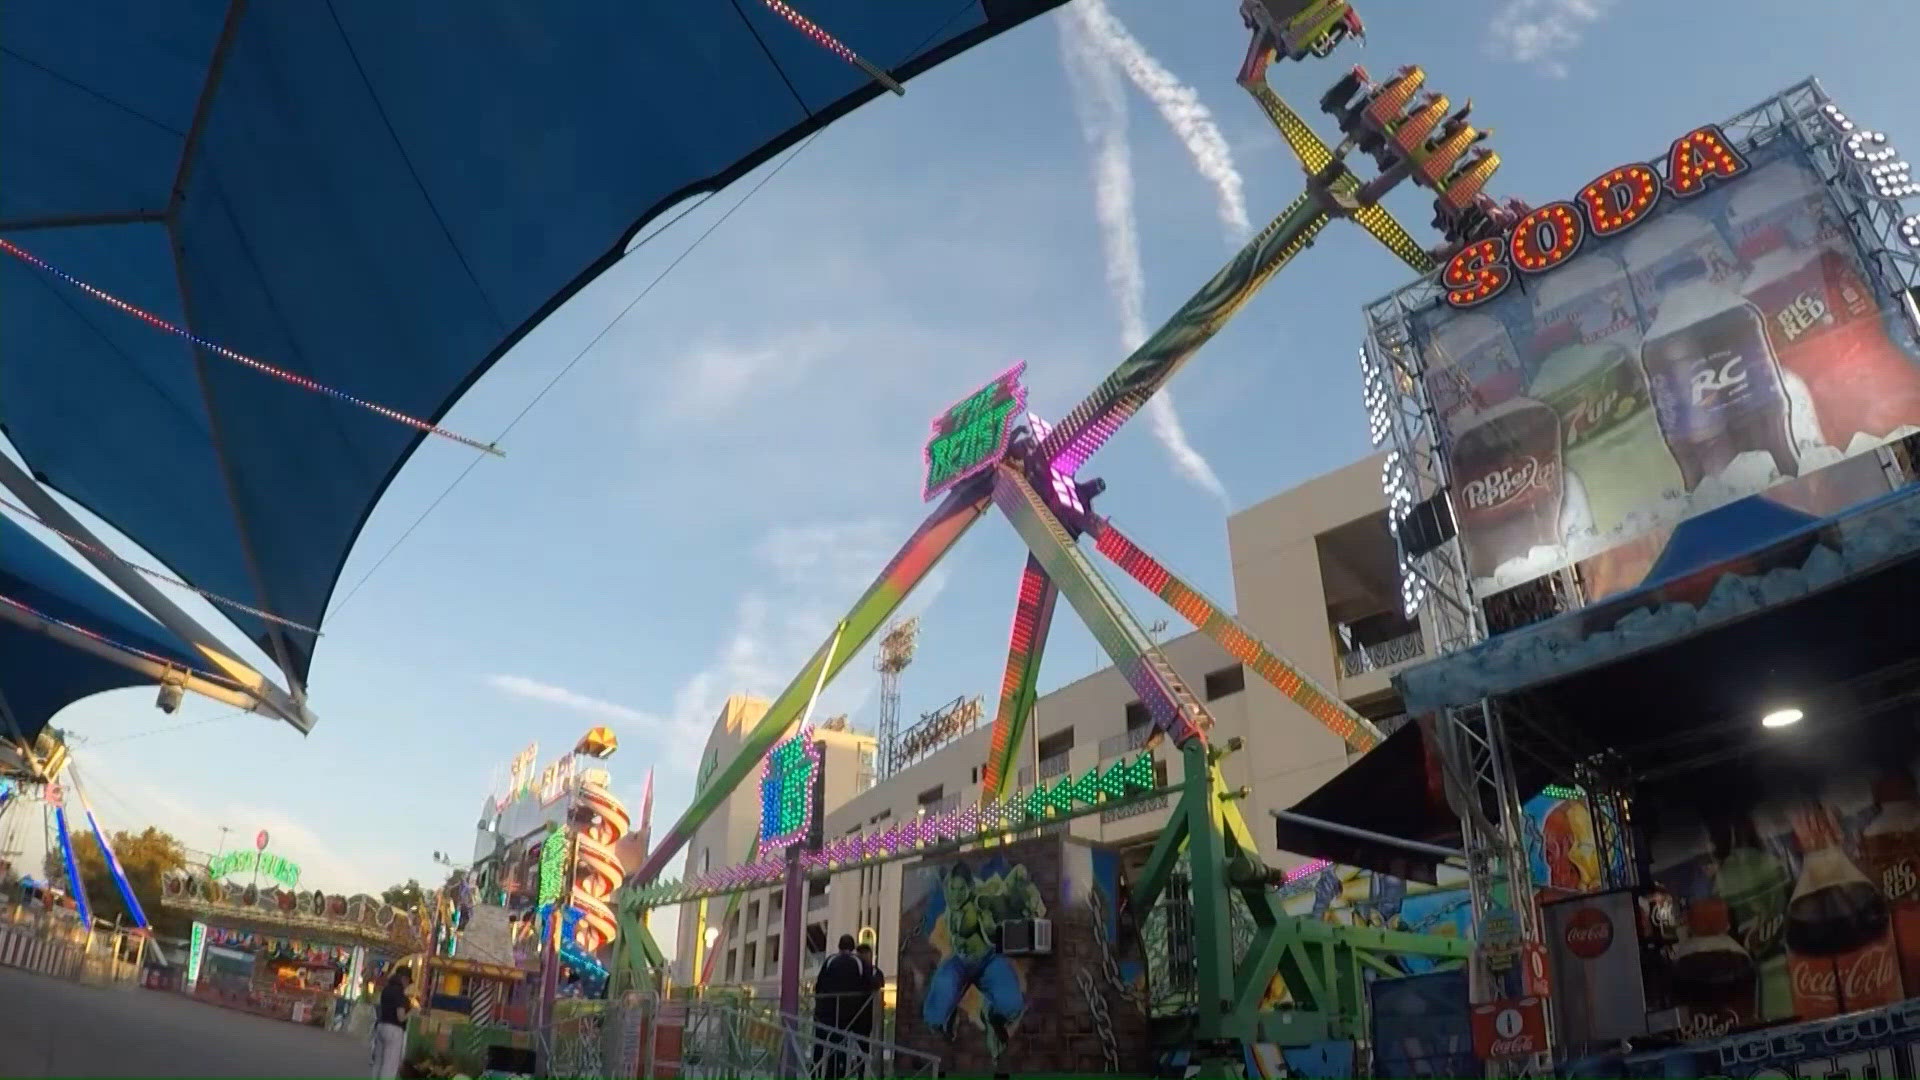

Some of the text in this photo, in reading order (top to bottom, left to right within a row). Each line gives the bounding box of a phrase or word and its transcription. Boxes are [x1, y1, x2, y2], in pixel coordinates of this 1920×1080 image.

[1441, 123, 1751, 309] SODA
[1778, 292, 1812, 327] BIG
[1784, 299, 1826, 341] RED
[1691, 355, 1747, 406] RC
[1464, 463, 1534, 509] Pepper
[1720, 1034, 1806, 1067] ICE
